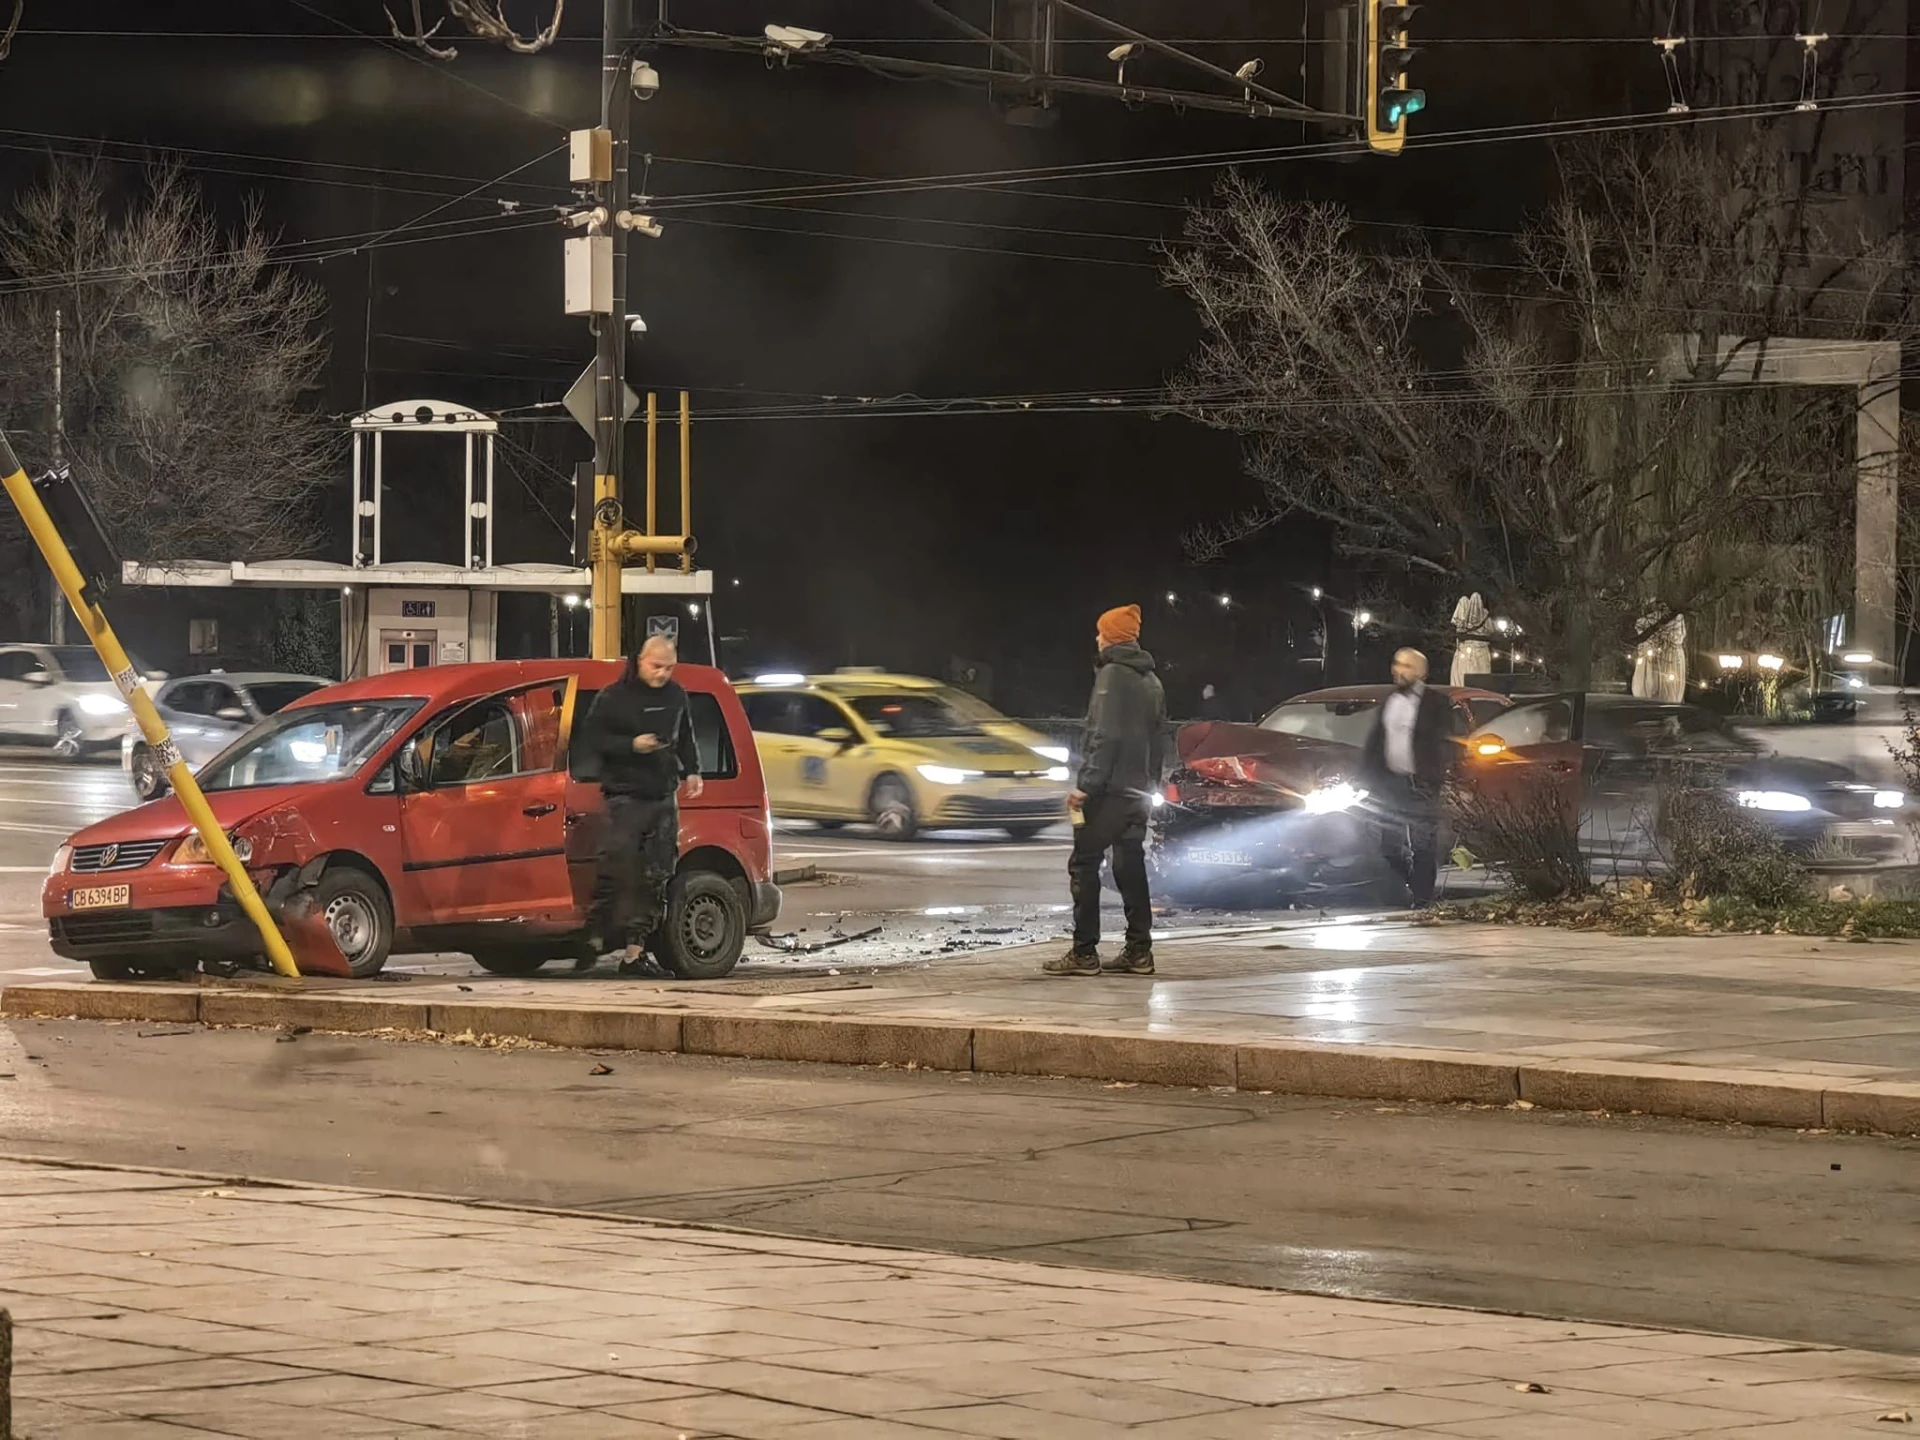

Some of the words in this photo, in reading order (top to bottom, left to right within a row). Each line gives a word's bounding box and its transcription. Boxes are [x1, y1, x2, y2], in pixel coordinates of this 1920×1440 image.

[74, 891, 86, 906] CB
[88, 888, 112, 905] 6394
[114, 886, 127, 903] BP
